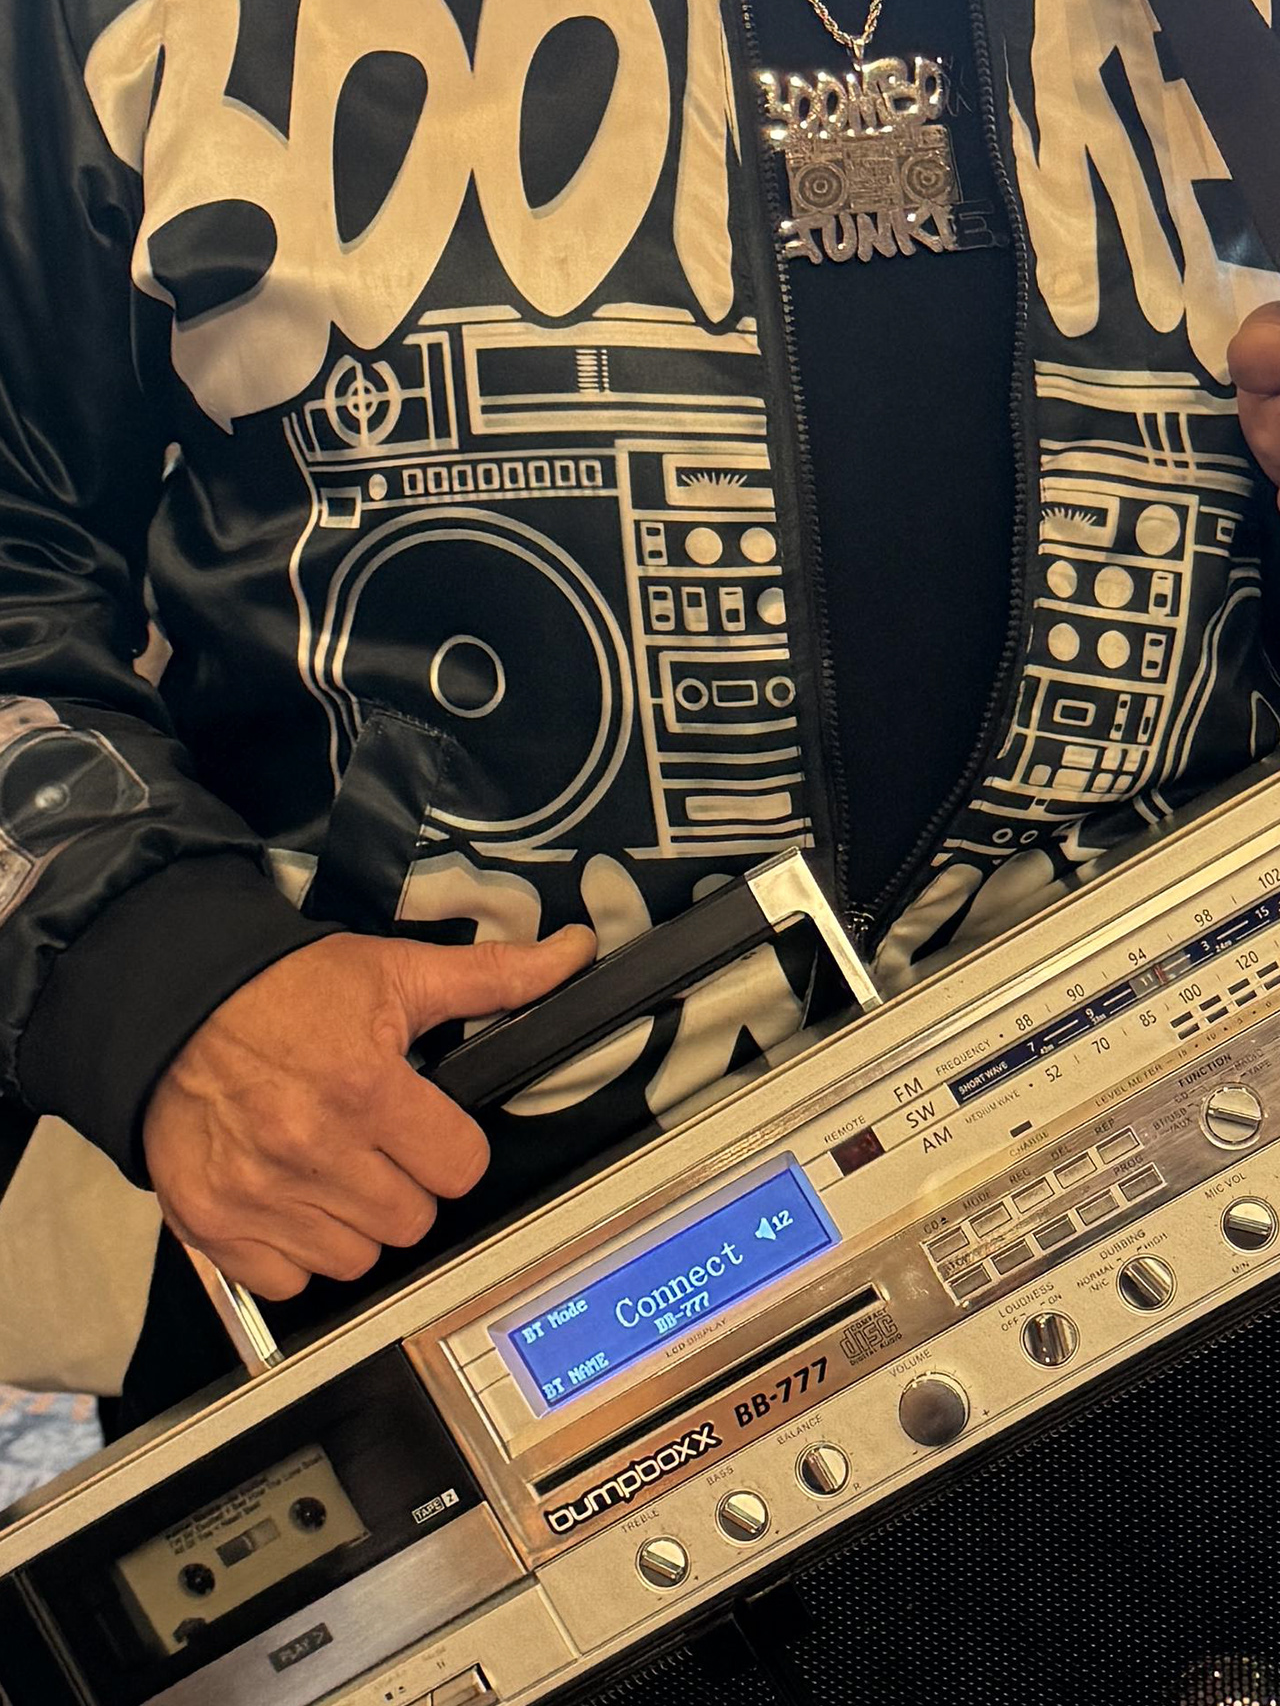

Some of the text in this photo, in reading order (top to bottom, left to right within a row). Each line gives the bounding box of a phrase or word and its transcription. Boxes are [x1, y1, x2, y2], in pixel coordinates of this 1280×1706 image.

[893, 1077, 925, 1104] FM
[935, 1038, 992, 1076] FREQUENCY
[1014, 1012, 1034, 1031] 88
[1066, 982, 1086, 1002] 90
[1127, 946, 1148, 966] 94
[1194, 908, 1215, 928] 98
[905, 1101, 938, 1129] SW
[1027, 1041, 1037, 1053] 7
[1085, 1007, 1095, 1019] 9
[1255, 905, 1270, 920] 15
[919, 1125, 954, 1154] AM
[1045, 1064, 1063, 1082] 52
[1092, 1035, 1111, 1054] 70
[1139, 1009, 1158, 1027] 85
[1179, 983, 1203, 1005] 100
[1235, 949, 1261, 972] 120
[1178, 1052, 1233, 1088] FUNCTION
[823, 1114, 867, 1145] REMOTE
[1113, 1153, 1145, 1177] PROG
[1204, 1170, 1247, 1200] MIC VOL
[1099, 1228, 1146, 1260] DUBBING
[612, 1209, 794, 1330] Connect 12
[1076, 1262, 1115, 1289] NORMAL
[654, 1290, 714, 1333] BB-777
[998, 1280, 1055, 1318] LOUDNESS
[522, 1296, 589, 1343] BT Mode
[838, 1310, 899, 1360] disc
[1000, 1315, 1021, 1332] OFF
[542, 1351, 610, 1400] BT NAME
[889, 1348, 932, 1379] VOLUME
[544, 1356, 830, 1537] bumpboxx BB-777
[776, 1413, 825, 1446] BALANCE
[706, 1464, 735, 1486] BASS
[414, 1499, 443, 1522] TAPE
[620, 1507, 660, 1535] TREBLE
